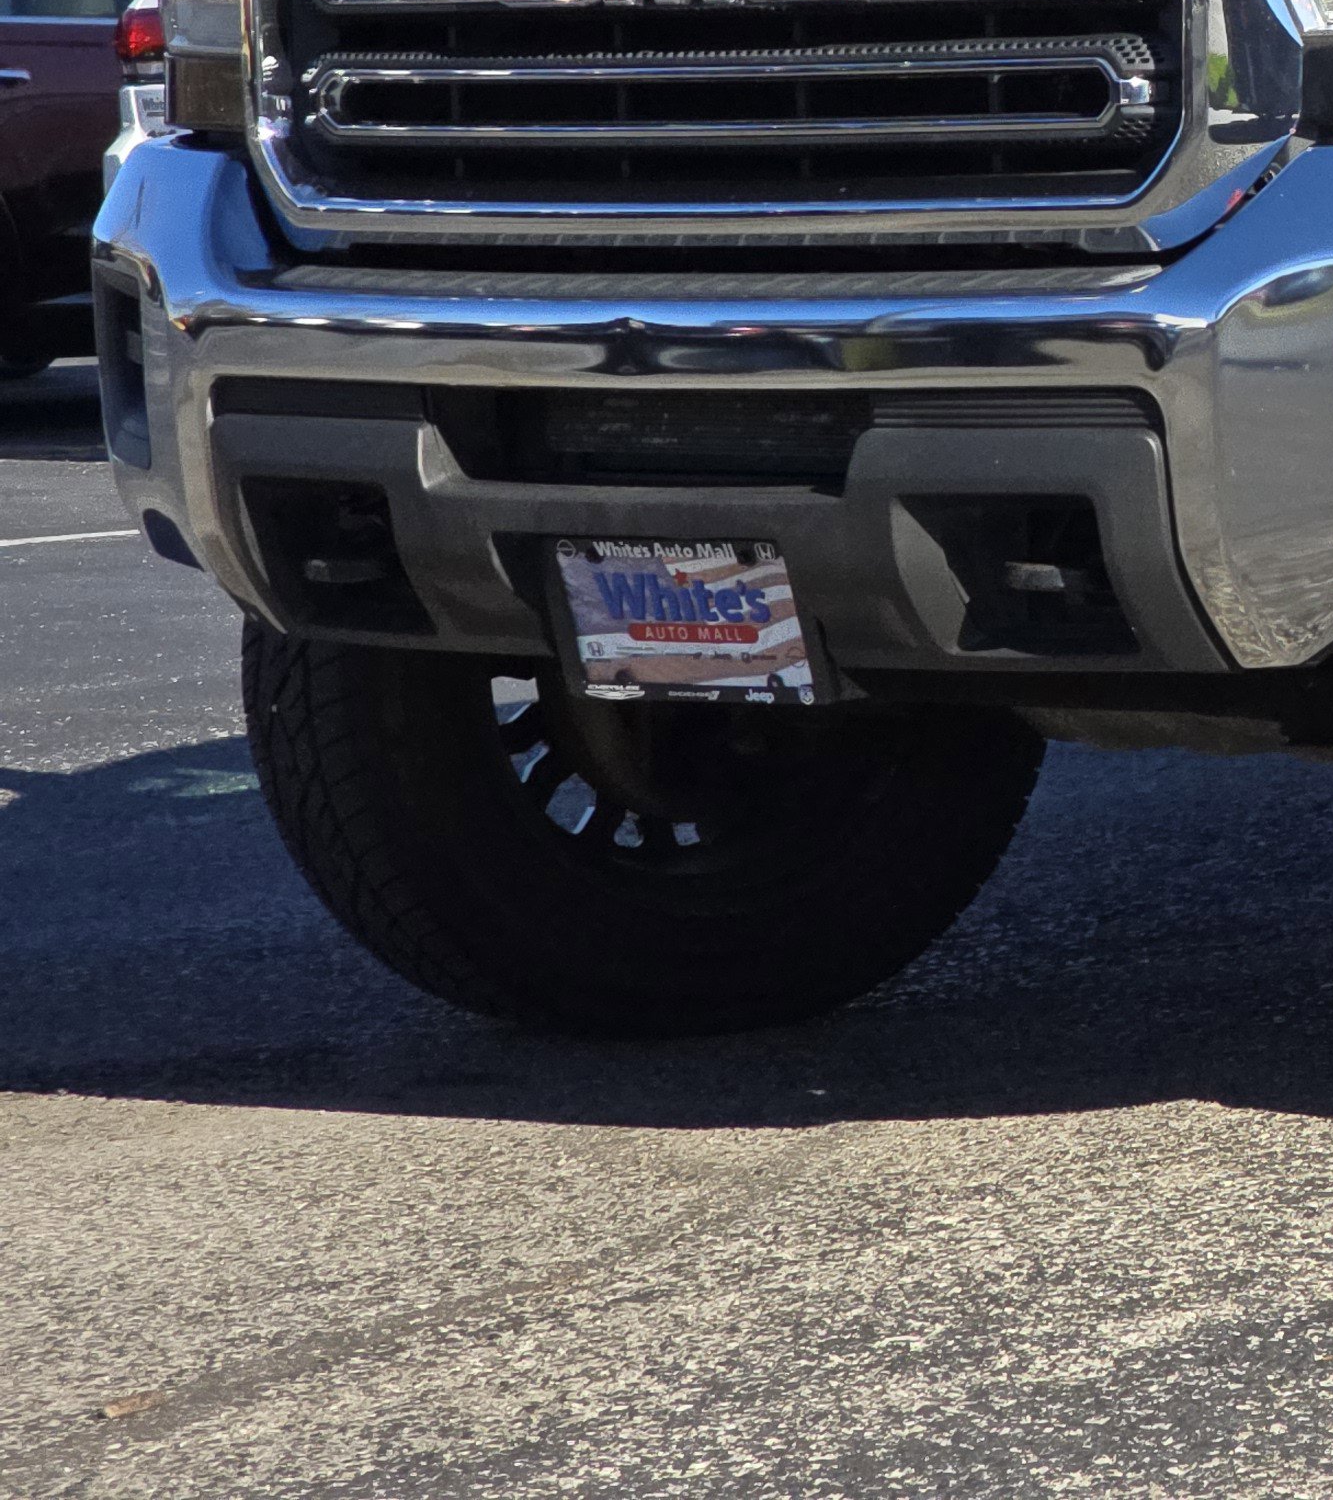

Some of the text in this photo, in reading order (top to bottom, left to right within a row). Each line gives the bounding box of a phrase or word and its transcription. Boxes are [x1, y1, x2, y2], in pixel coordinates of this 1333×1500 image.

[592, 541, 737, 560] White's Auto Mall
[593, 568, 772, 624] White's
[644, 626, 743, 642] AUTO MALL
